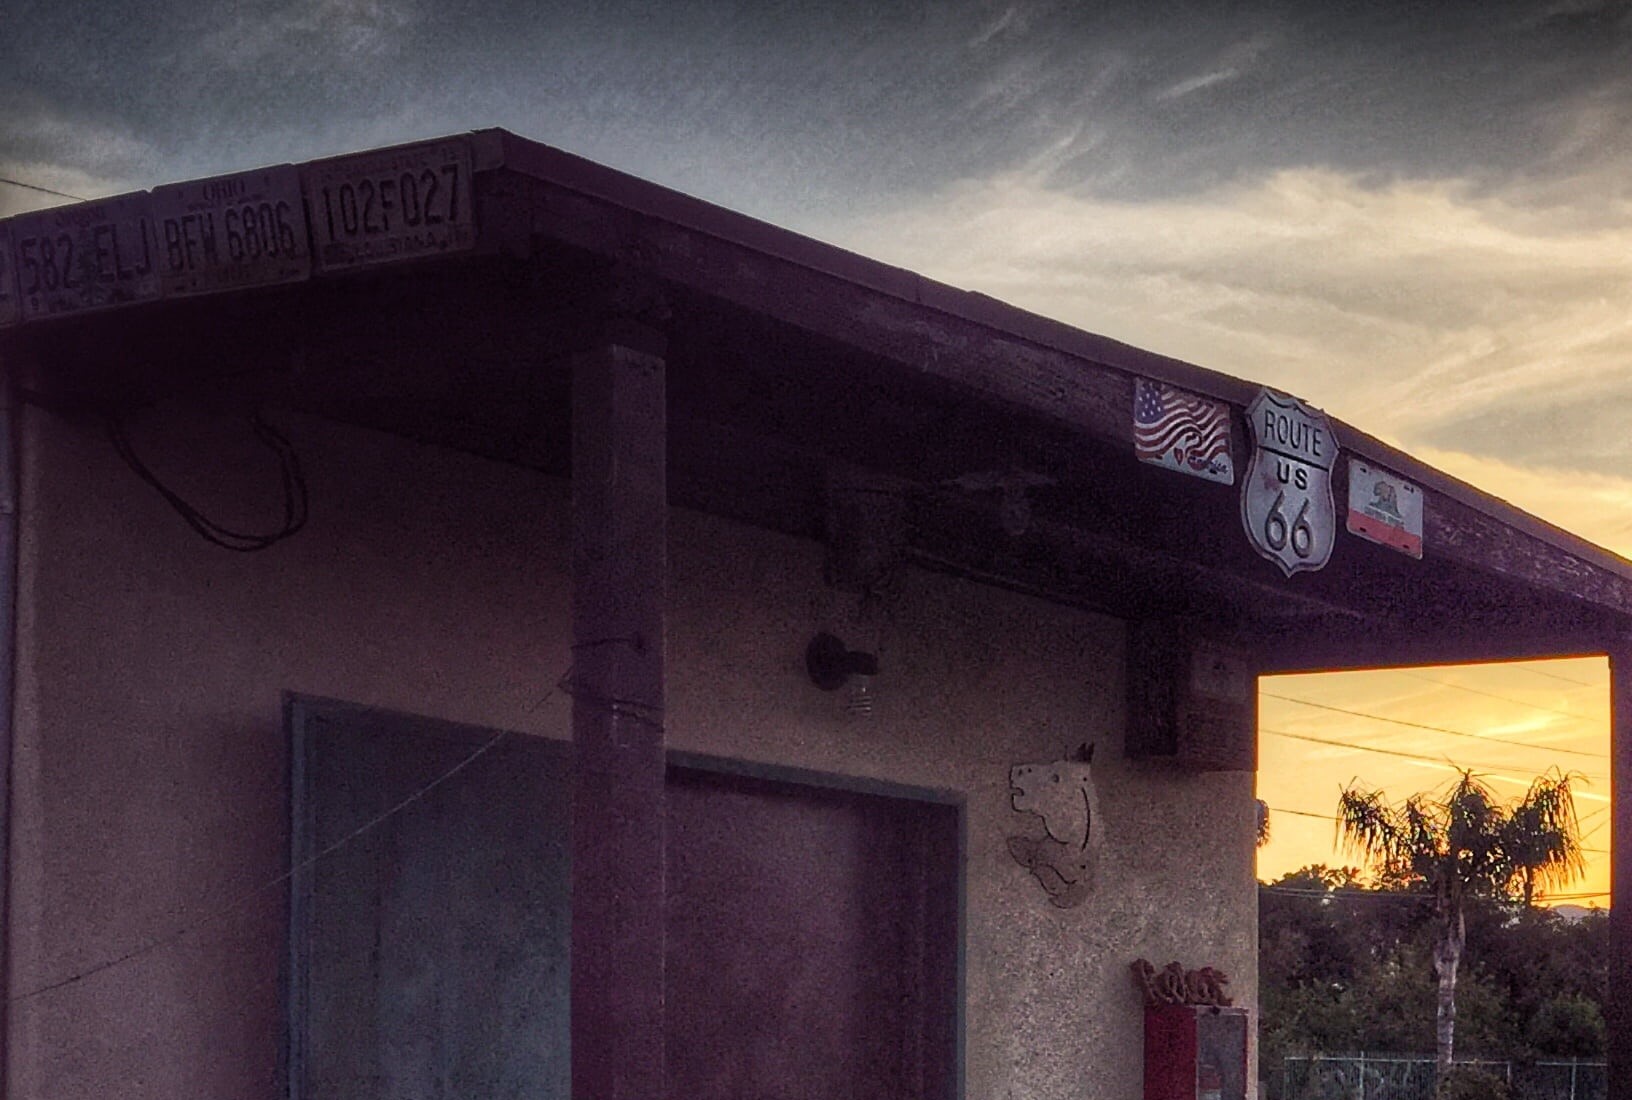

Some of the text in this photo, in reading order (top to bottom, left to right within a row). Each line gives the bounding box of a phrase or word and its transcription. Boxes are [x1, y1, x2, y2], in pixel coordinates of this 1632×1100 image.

[202, 179, 245, 200] OHIO
[322, 163, 458, 241] 102F027
[21, 218, 151, 294] 582 ELJ
[225, 201, 296, 261] 6806
[1264, 410, 1323, 457] ROUTE
[1276, 460, 1308, 490] US
[1264, 490, 1314, 559] 66
